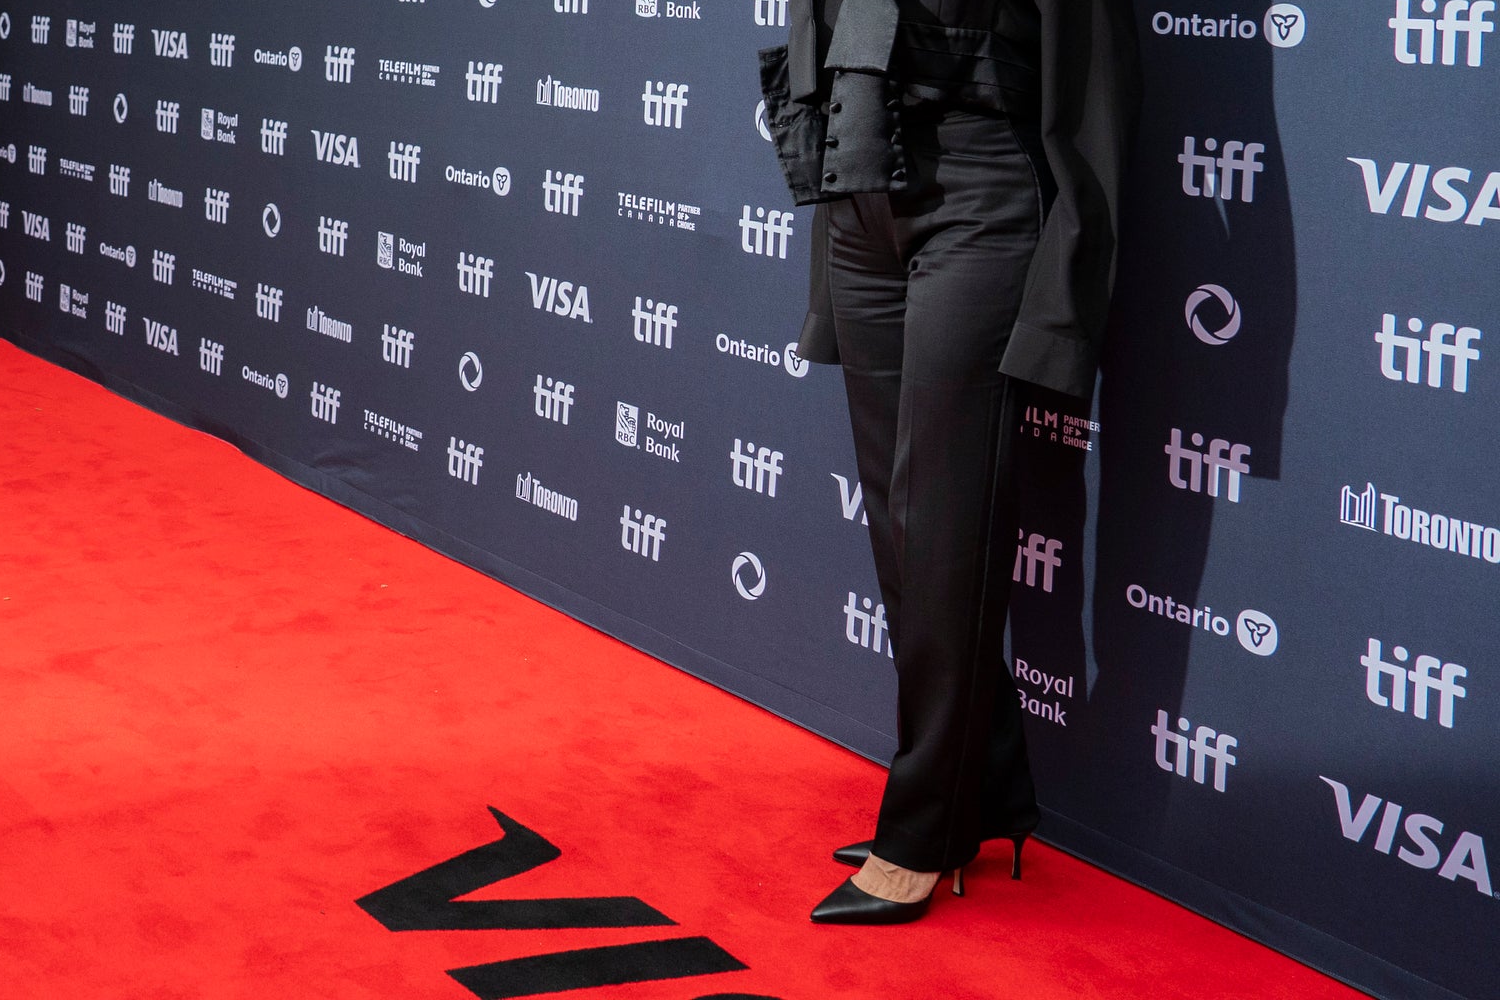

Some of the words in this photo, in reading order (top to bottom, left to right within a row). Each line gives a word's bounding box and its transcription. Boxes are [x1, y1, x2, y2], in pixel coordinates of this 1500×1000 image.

[666, 1, 701, 19] Bank
[1153, 12, 1256, 38] Ontario
[151, 30, 188, 59] VISA
[254, 49, 287, 66] Ontario
[325, 46, 355, 83] tiff
[553, 81, 599, 112] TORONTO
[642, 81, 688, 128] tiff
[311, 130, 360, 168] VISA
[388, 141, 420, 183] tiff
[446, 166, 490, 188] Ontario
[1178, 136, 1264, 203] tiff
[543, 170, 584, 216] tiff
[618, 192, 675, 216] TELEFILM
[677, 203, 701, 215] PARTNER
[22, 211, 50, 241] VISA
[318, 216, 348, 256] tiff
[618, 208, 674, 227] CANADA
[739, 205, 794, 259] tiff
[399, 238, 425, 258] Royal
[399, 258, 422, 277] Bank
[525, 272, 593, 323] VISA
[105, 301, 126, 335] tiff
[143, 317, 178, 356] VISA
[319, 311, 352, 343] TORONTO
[632, 297, 677, 349] tiff
[382, 324, 414, 368] tiff
[716, 334, 780, 366] Ontario
[1375, 314, 1481, 392] tiff
[242, 366, 274, 390] Ontario
[311, 382, 340, 424] tiff
[647, 413, 684, 439] Royal
[1062, 435, 1093, 451] CHOICE
[1063, 414, 1101, 433] PARTNER
[1063, 424, 1075, 436] OF
[646, 436, 679, 462] Bank
[730, 439, 783, 497] tiff
[1165, 428, 1250, 503] tiff
[533, 479, 577, 521] TORONTO
[620, 505, 666, 561] tiff
[1012, 529, 1063, 593] iff
[843, 591, 894, 659] tif
[1127, 585, 1229, 636] Ontario
[1015, 657, 1074, 698] Royal
[1361, 638, 1467, 728] tiff
[1151, 710, 1237, 792] tiff
[1319, 775, 1493, 897] VISA
[354, 805, 790, 1000] VI
